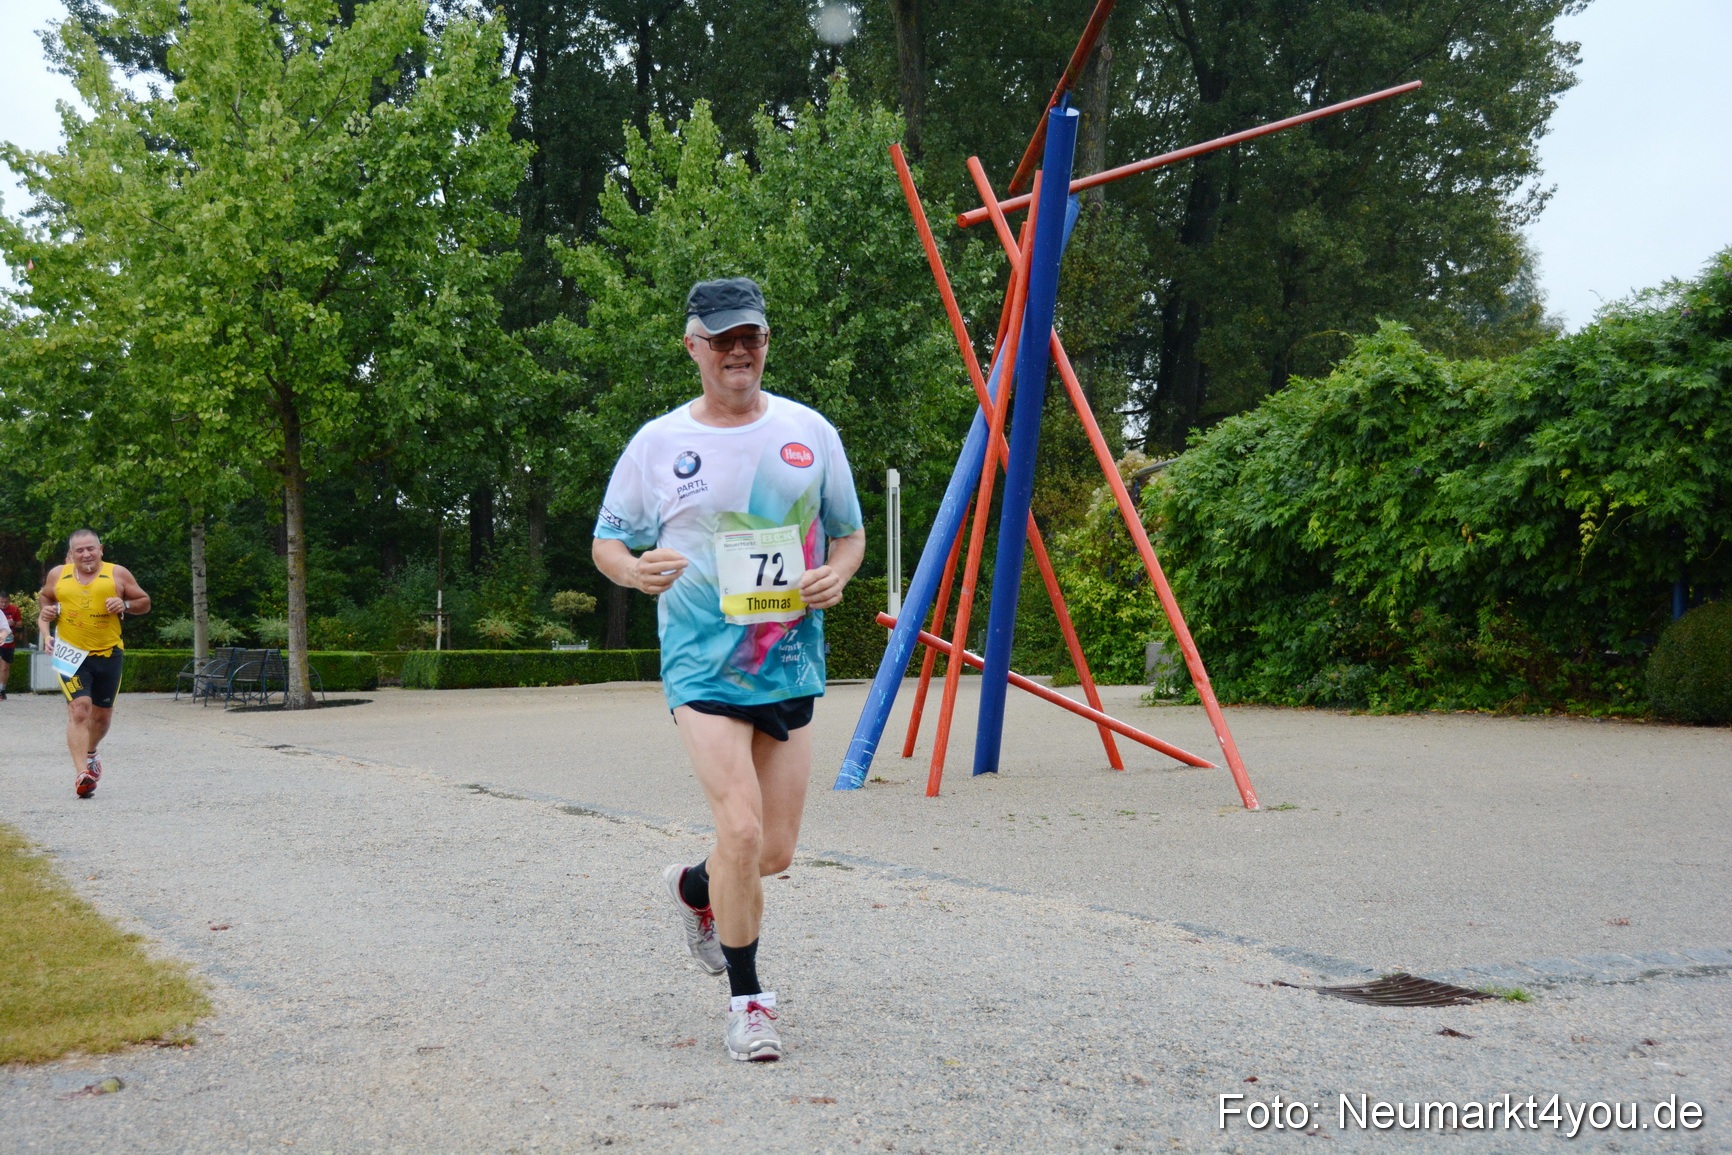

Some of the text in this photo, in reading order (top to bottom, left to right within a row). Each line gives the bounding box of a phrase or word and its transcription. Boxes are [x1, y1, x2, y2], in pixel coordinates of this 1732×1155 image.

[677, 479, 707, 495] PARTL
[761, 530, 795, 544] BCK
[750, 552, 788, 586] 72
[746, 597, 791, 611] Thomas
[54, 643, 82, 665] 3028
